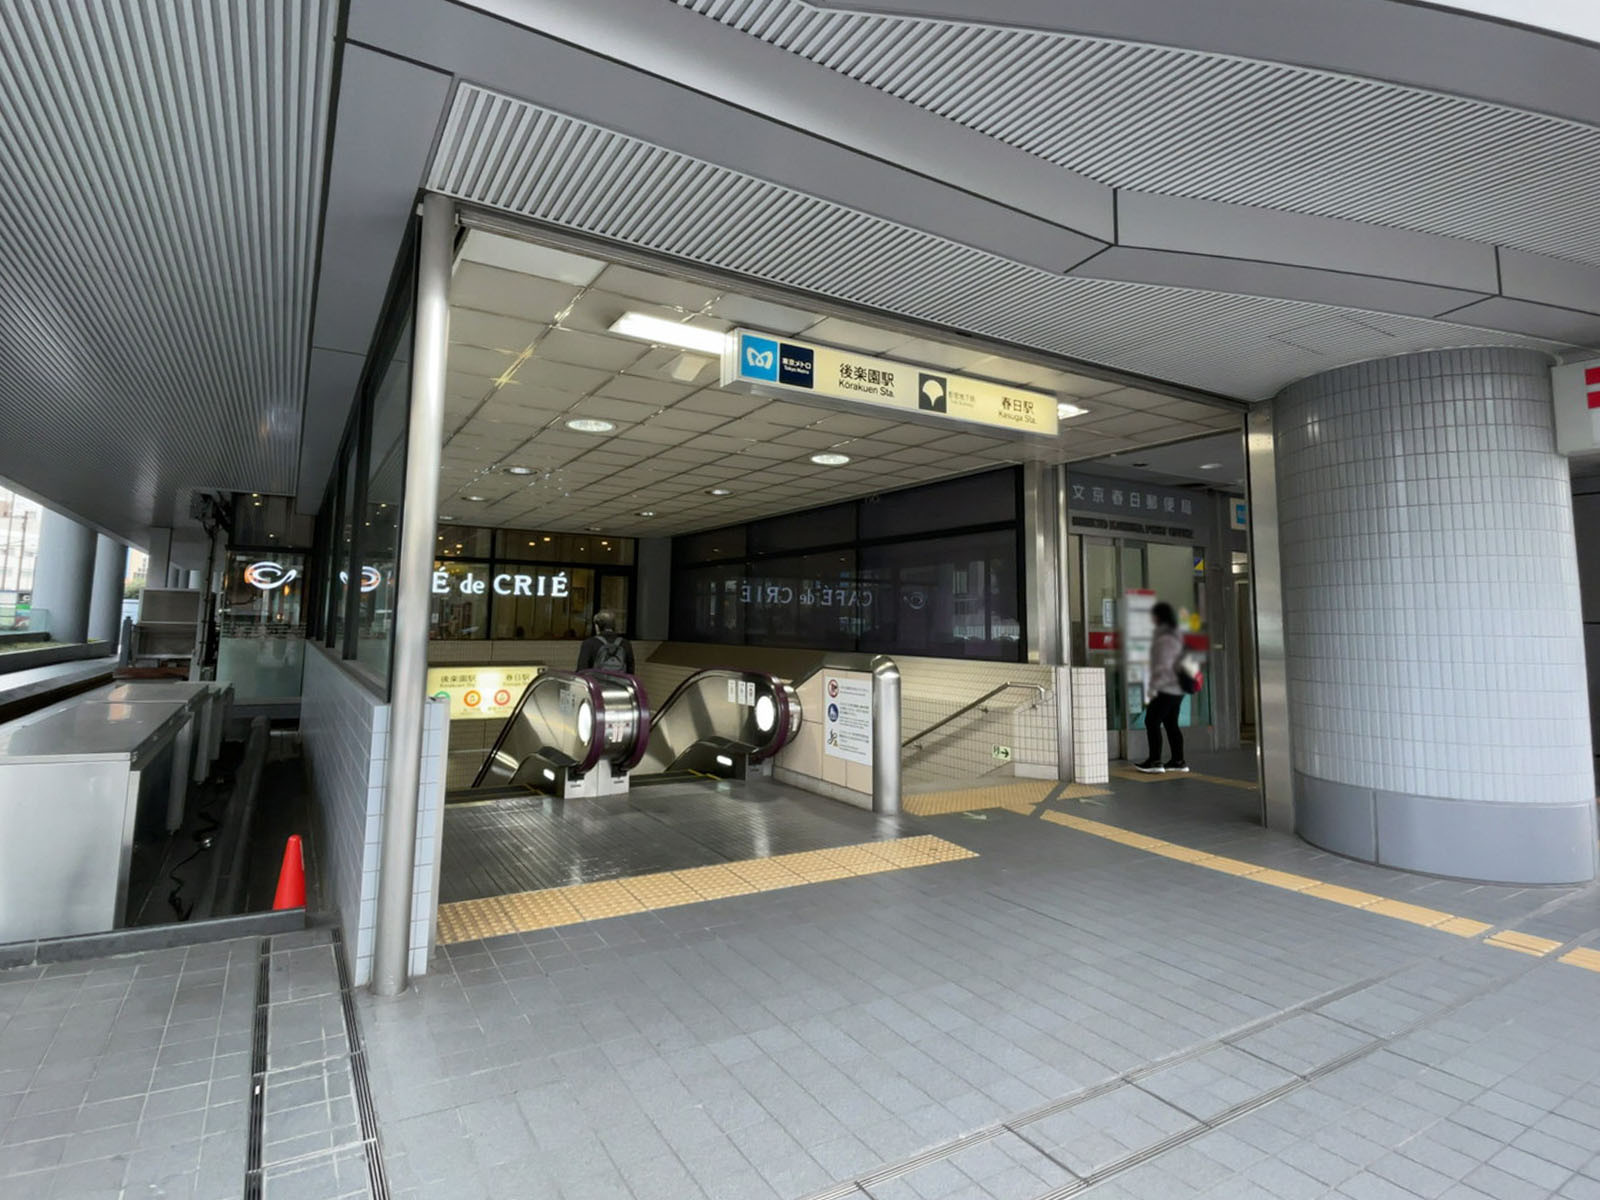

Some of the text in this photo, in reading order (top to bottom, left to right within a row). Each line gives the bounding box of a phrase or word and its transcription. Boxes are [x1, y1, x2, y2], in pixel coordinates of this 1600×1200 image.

[839, 363, 895, 388] 後楽園駅
[998, 411, 1023, 422] Kasuga
[1001, 396, 1034, 415] 春日駅
[460, 573, 486, 594] de
[493, 571, 569, 597] CRIÉ
